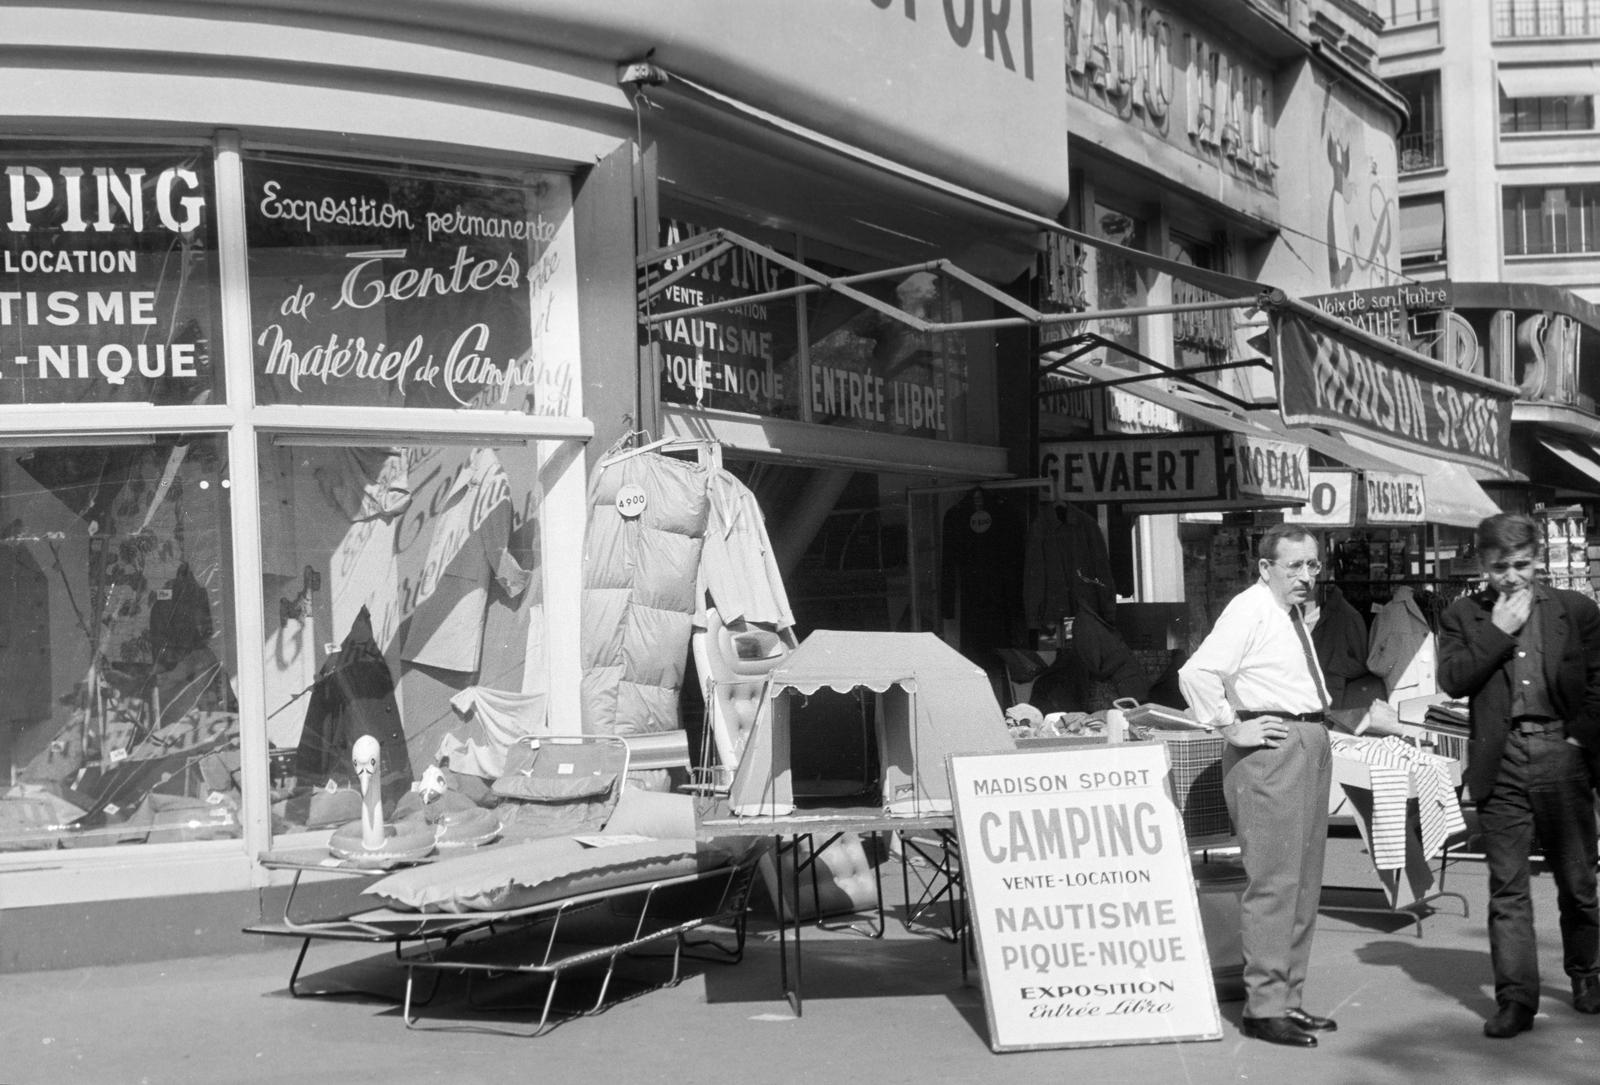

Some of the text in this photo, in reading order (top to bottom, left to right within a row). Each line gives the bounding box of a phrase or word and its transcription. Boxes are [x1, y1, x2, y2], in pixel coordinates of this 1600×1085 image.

[260, 180, 556, 243] Exposition permanente
[4, 250, 137, 274] LOCATION
[280, 245, 520, 324] de Tentes
[1371, 294, 1395, 309] son
[0, 290, 158, 327] TISME
[660, 317, 773, 362] NAUTISME
[257, 322, 572, 411] Matériel de Camping
[811, 365, 947, 431] ENTRÉE LIBRE
[1312, 331, 1429, 443] MADISON
[1040, 450, 1200, 494] GEVAERT
[1237, 445, 1306, 492] KODAK
[1367, 479, 1424, 516] DISQUES
[973, 769, 1150, 796] MADISON SPORT
[979, 802, 1164, 865] CAMPING
[994, 900, 1177, 934] NAUTISME
[1000, 937, 1186, 974] PIQUE-NIQUE
[1020, 980, 1175, 1000] EXPOSITION
[1029, 998, 1175, 1020] Entrée Libre
